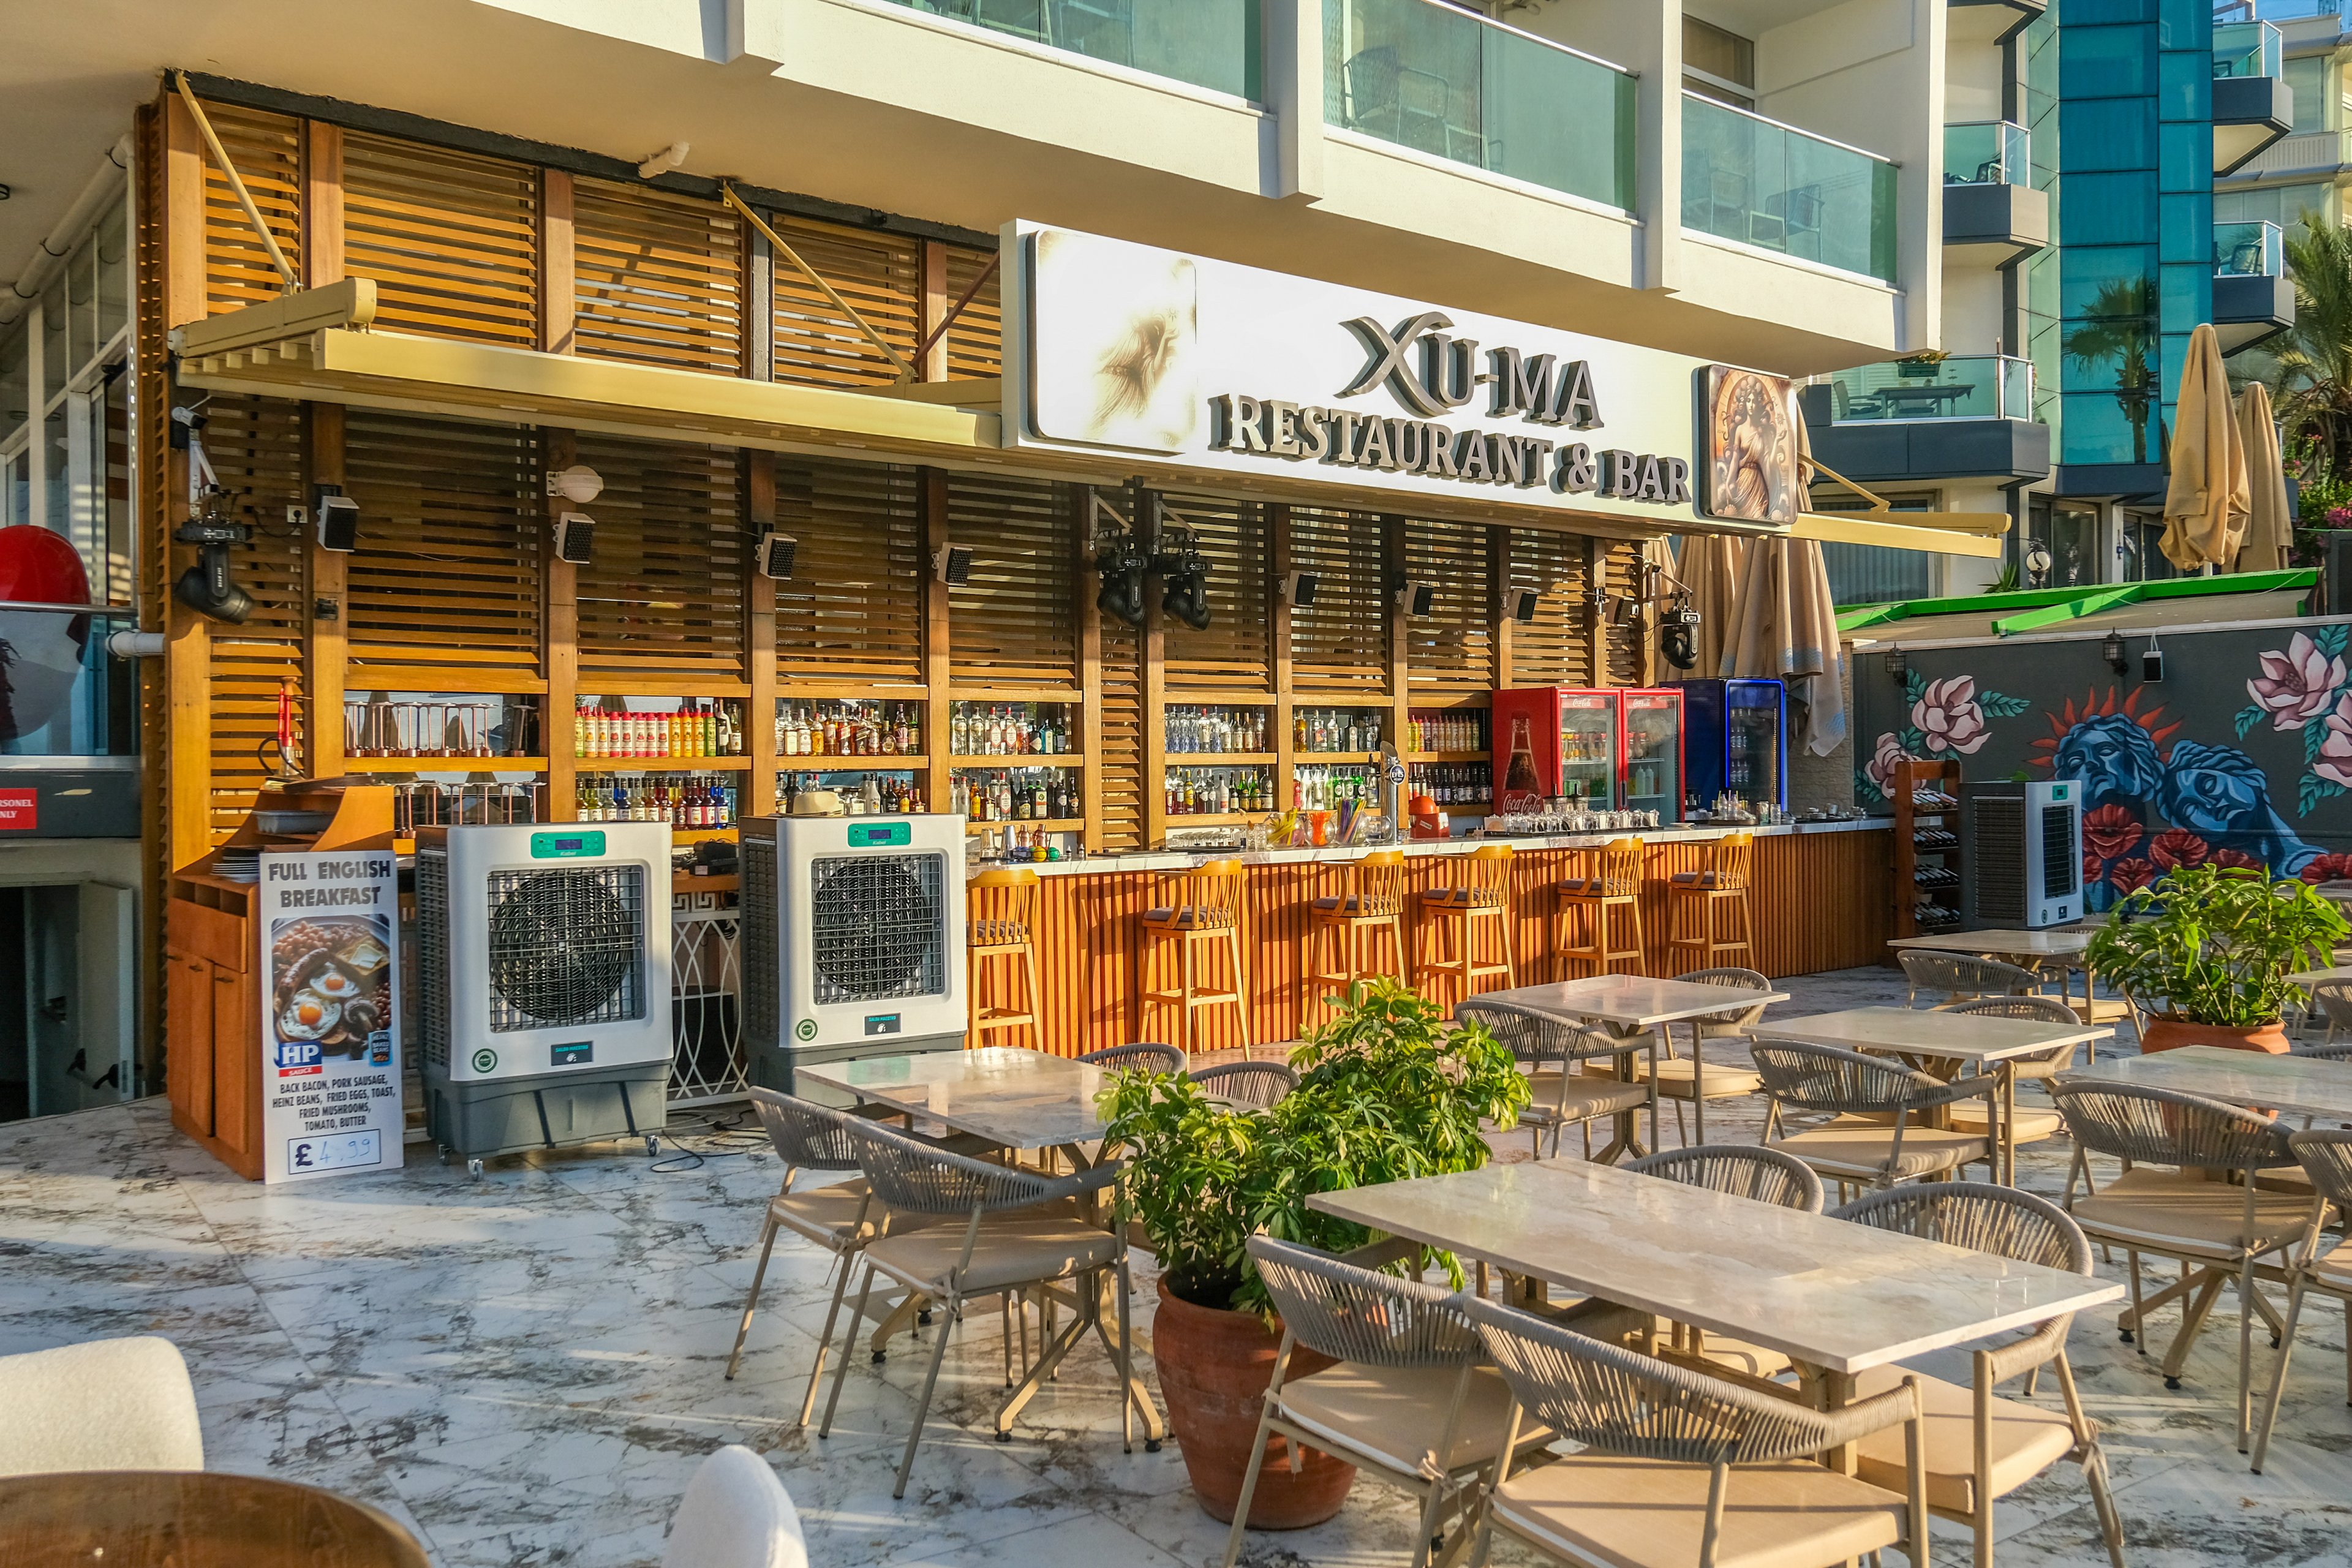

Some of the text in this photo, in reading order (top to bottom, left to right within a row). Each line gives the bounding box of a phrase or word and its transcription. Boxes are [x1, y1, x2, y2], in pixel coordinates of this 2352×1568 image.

[1333, 311, 1604, 431] XU-MA
[1208, 394, 1692, 505] RESTAURANT & BAR
[268, 861, 391, 881] FULL ENGLISH
[280, 886, 381, 908] BREAKFAST
[282, 1044, 319, 1065] HP
[288, 1067, 313, 1076] SAUCE
[280, 1074, 388, 1094] BACK BACON, PORK SAUSAGE,
[273, 1087, 396, 1108] HEINZ BEANS, FRIED EGGS, TOAST,
[299, 1102, 371, 1119] FRIED MUSHROOMS,
[304, 1115, 366, 1131] TOMATO, BUTTER
[295, 1143, 313, 1167] £
